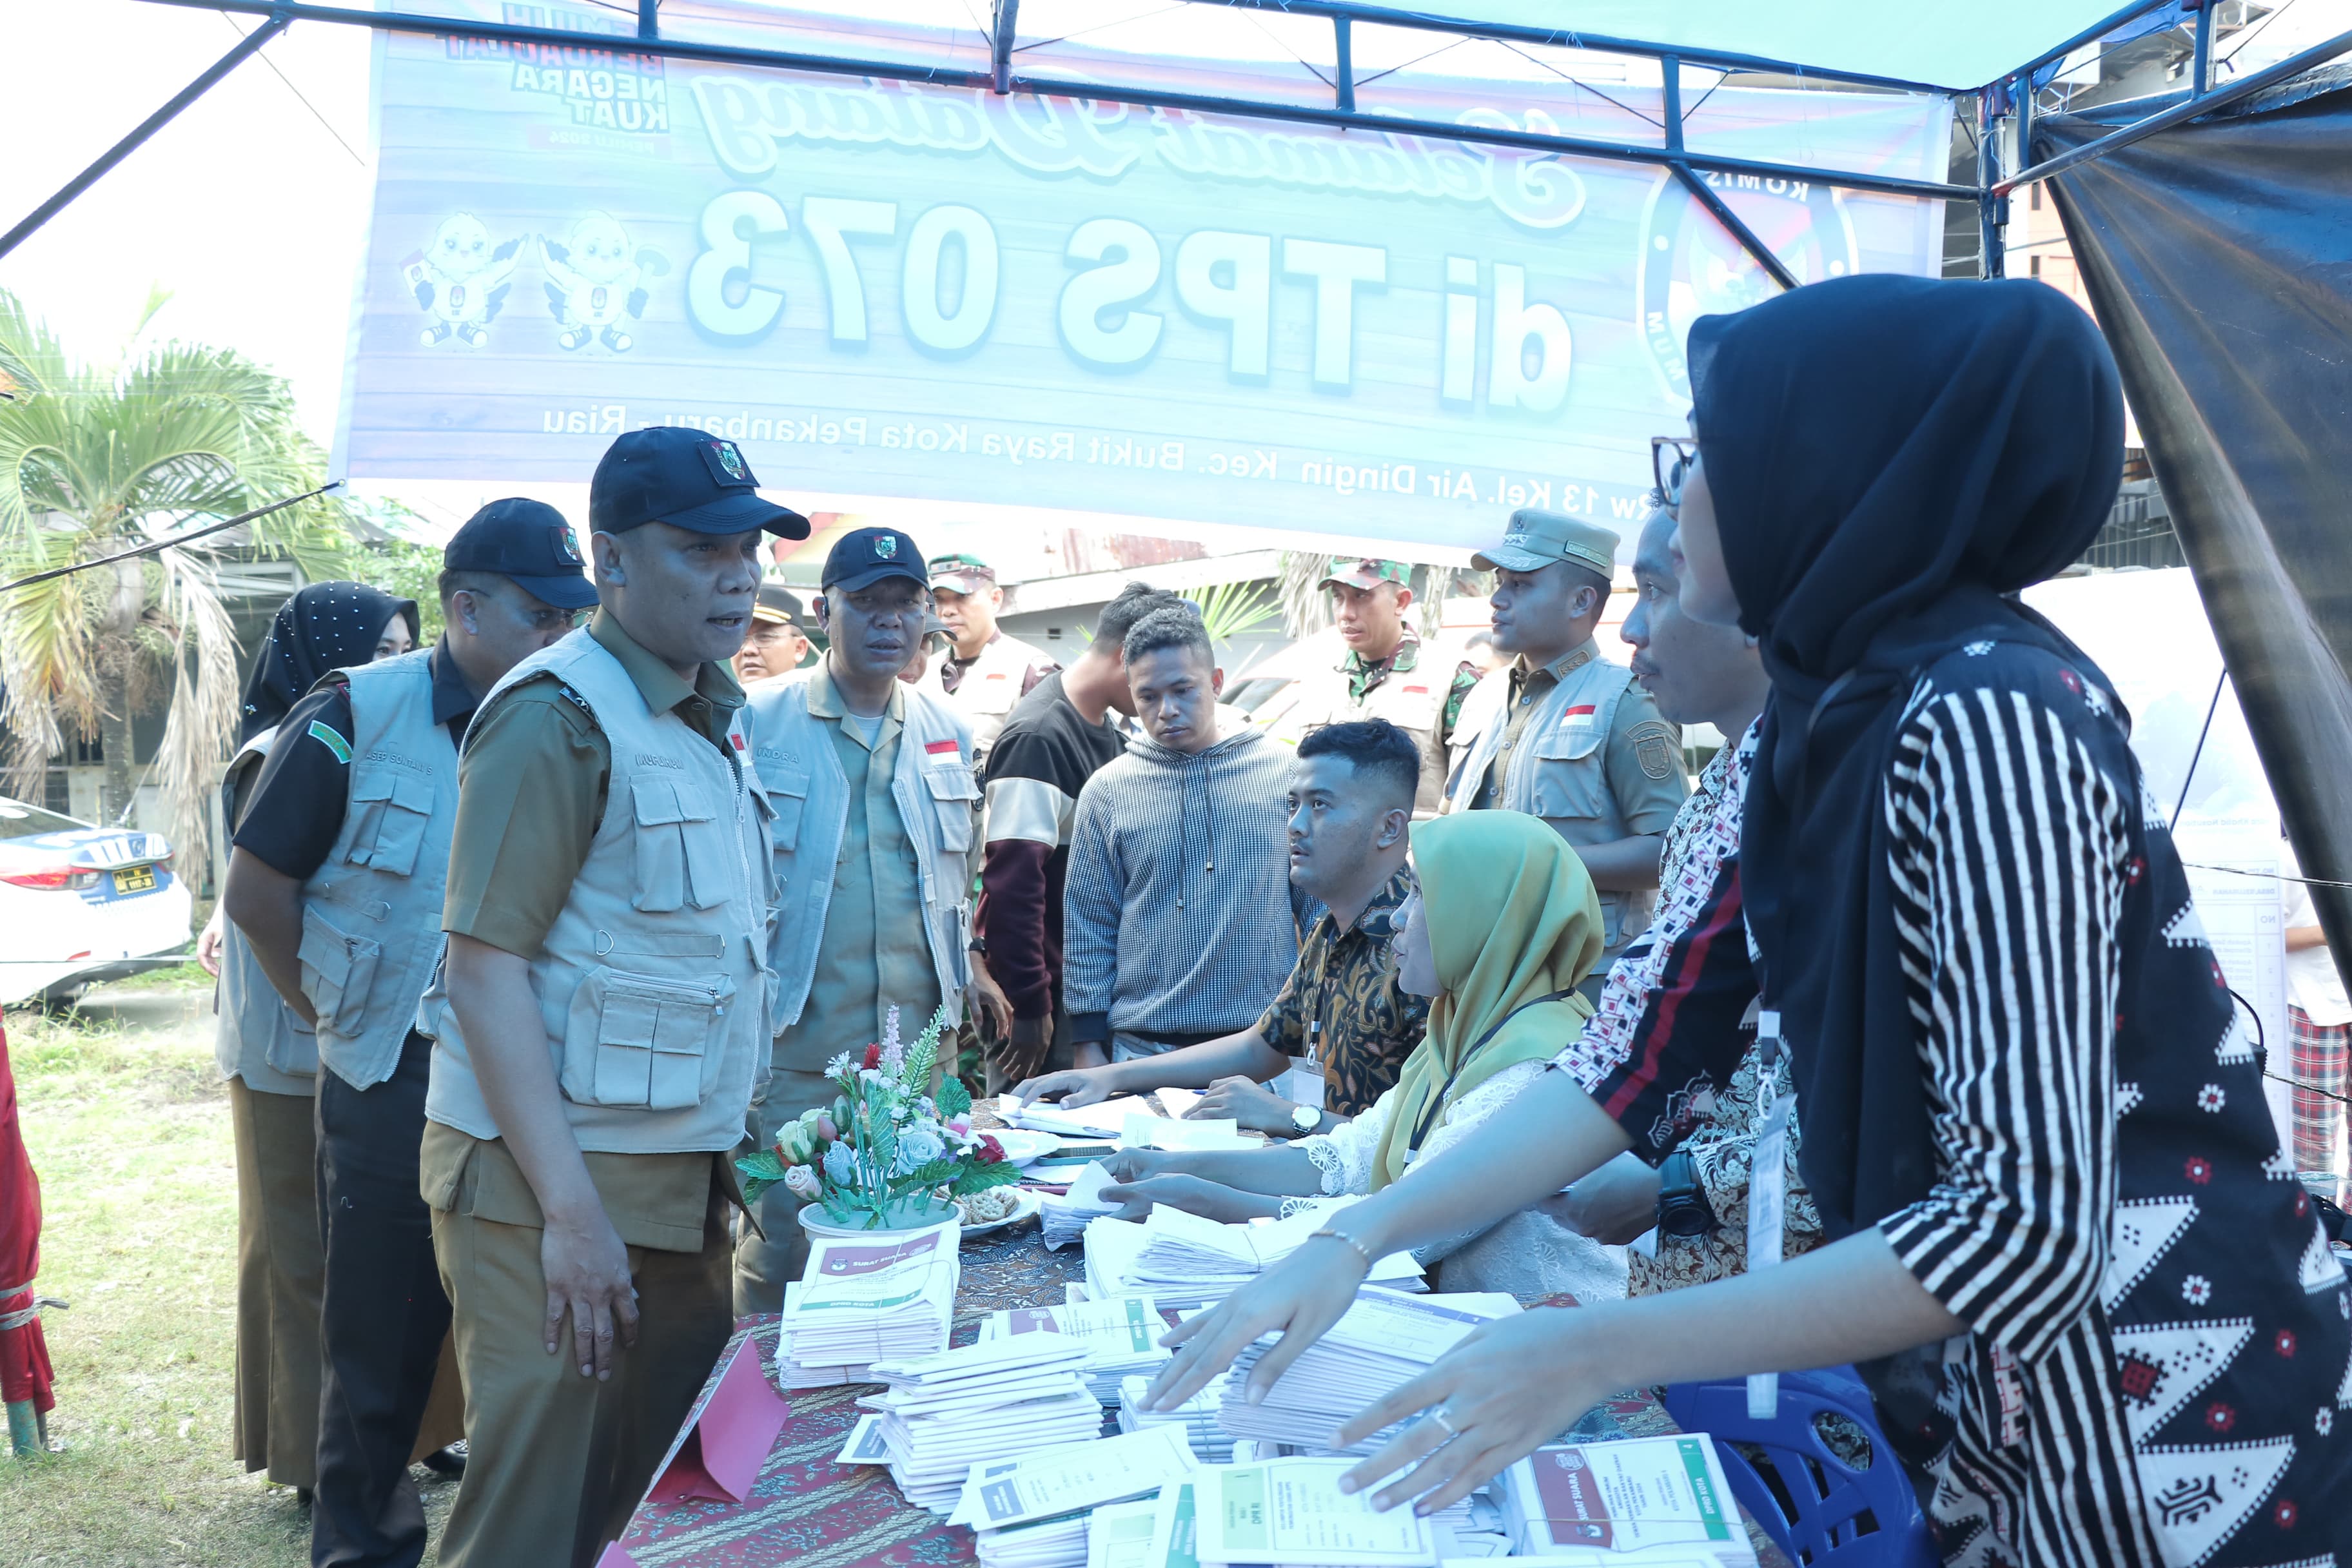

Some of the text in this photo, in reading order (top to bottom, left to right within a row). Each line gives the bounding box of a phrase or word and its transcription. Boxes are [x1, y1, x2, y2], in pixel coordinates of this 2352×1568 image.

[366, 750, 387, 762] ASEP
[757, 747, 799, 765] INDRA
[852, 1252, 907, 1267] SURAT SUARA
[1035, 1319, 1044, 1331] UARA
[1567, 1473, 1583, 1500] SUARA
[1695, 1477, 1716, 1514] DPRD KOTA
[1250, 1511, 1262, 1525] DPR
[1573, 1500, 1590, 1522] SURAT
